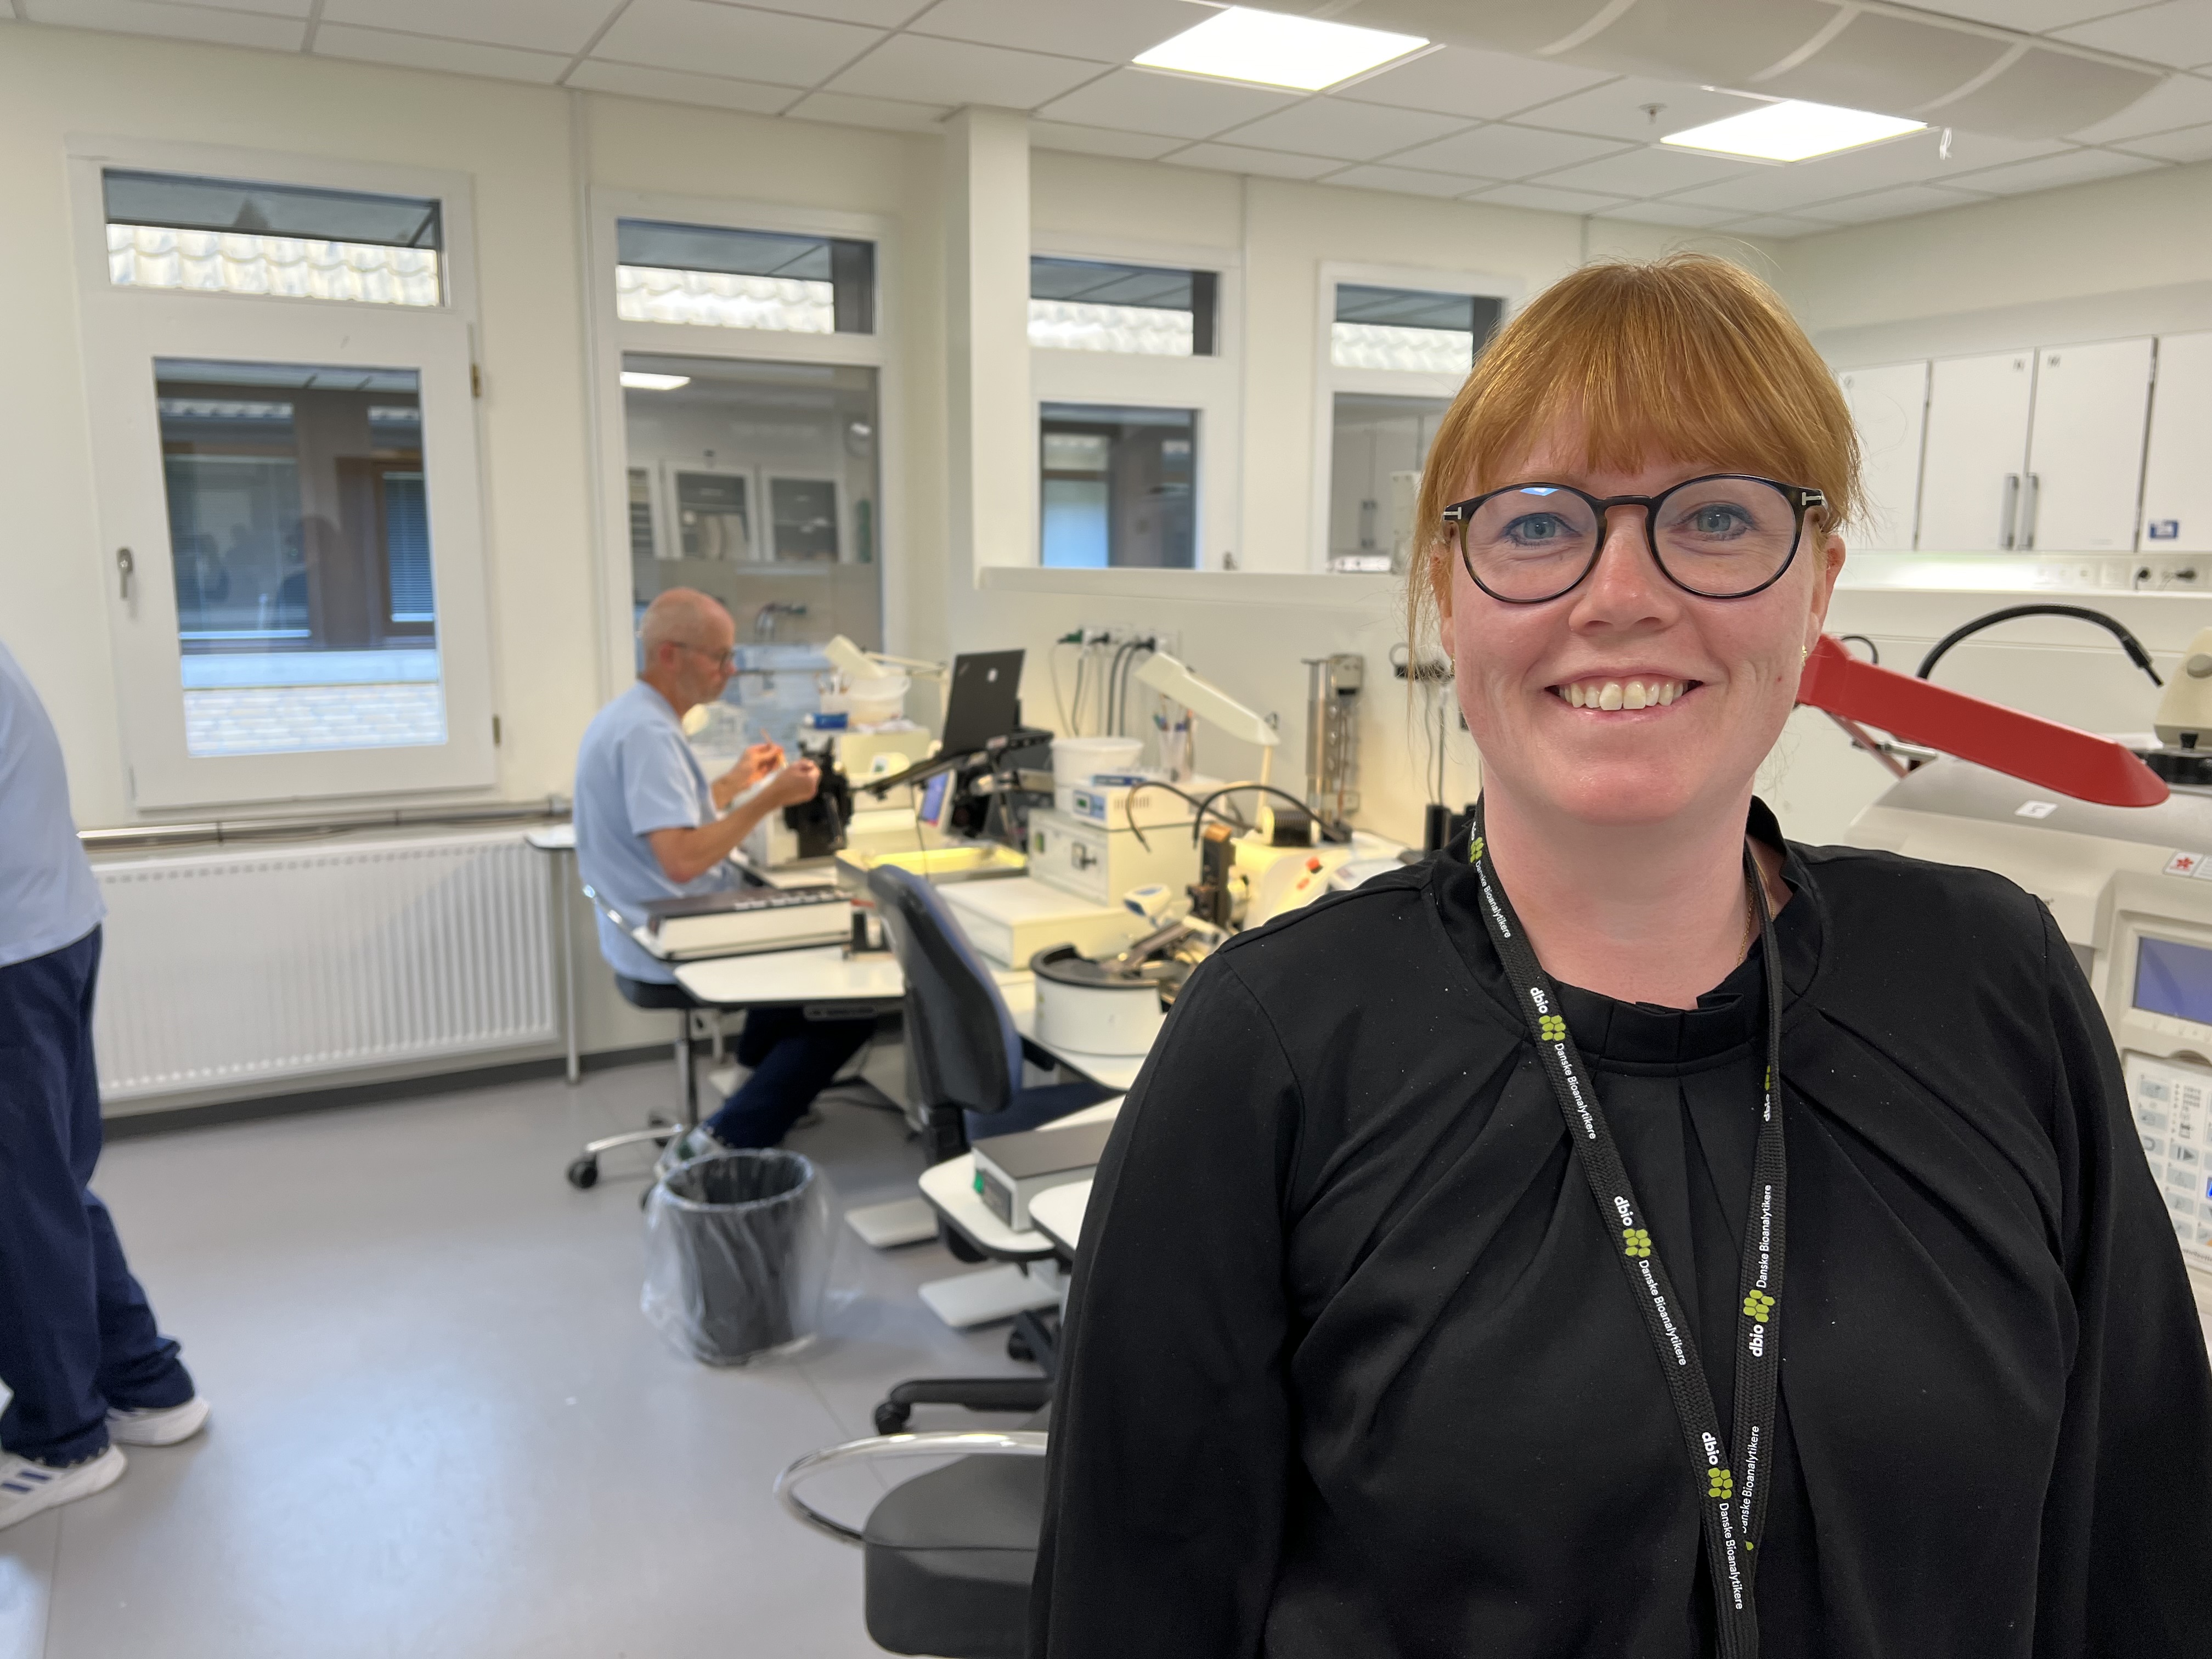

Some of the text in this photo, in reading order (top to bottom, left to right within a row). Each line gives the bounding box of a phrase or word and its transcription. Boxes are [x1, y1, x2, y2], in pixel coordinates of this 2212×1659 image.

[1475, 860, 1487, 887] Danske
[1483, 885, 1511, 938] Bioanalytikere
[1530, 987, 1596, 1139] dbio Danske Bioanalytikere
[1614, 1195, 1686, 1365] dbio Danske Bioanalytikere
[1748, 1184, 1773, 1357] dbio Danske Bioanalytikere
[1701, 1432, 1743, 1610] dbio Danske Bioanalytikere
[1741, 1425, 1759, 1497] Bioanalytikere
